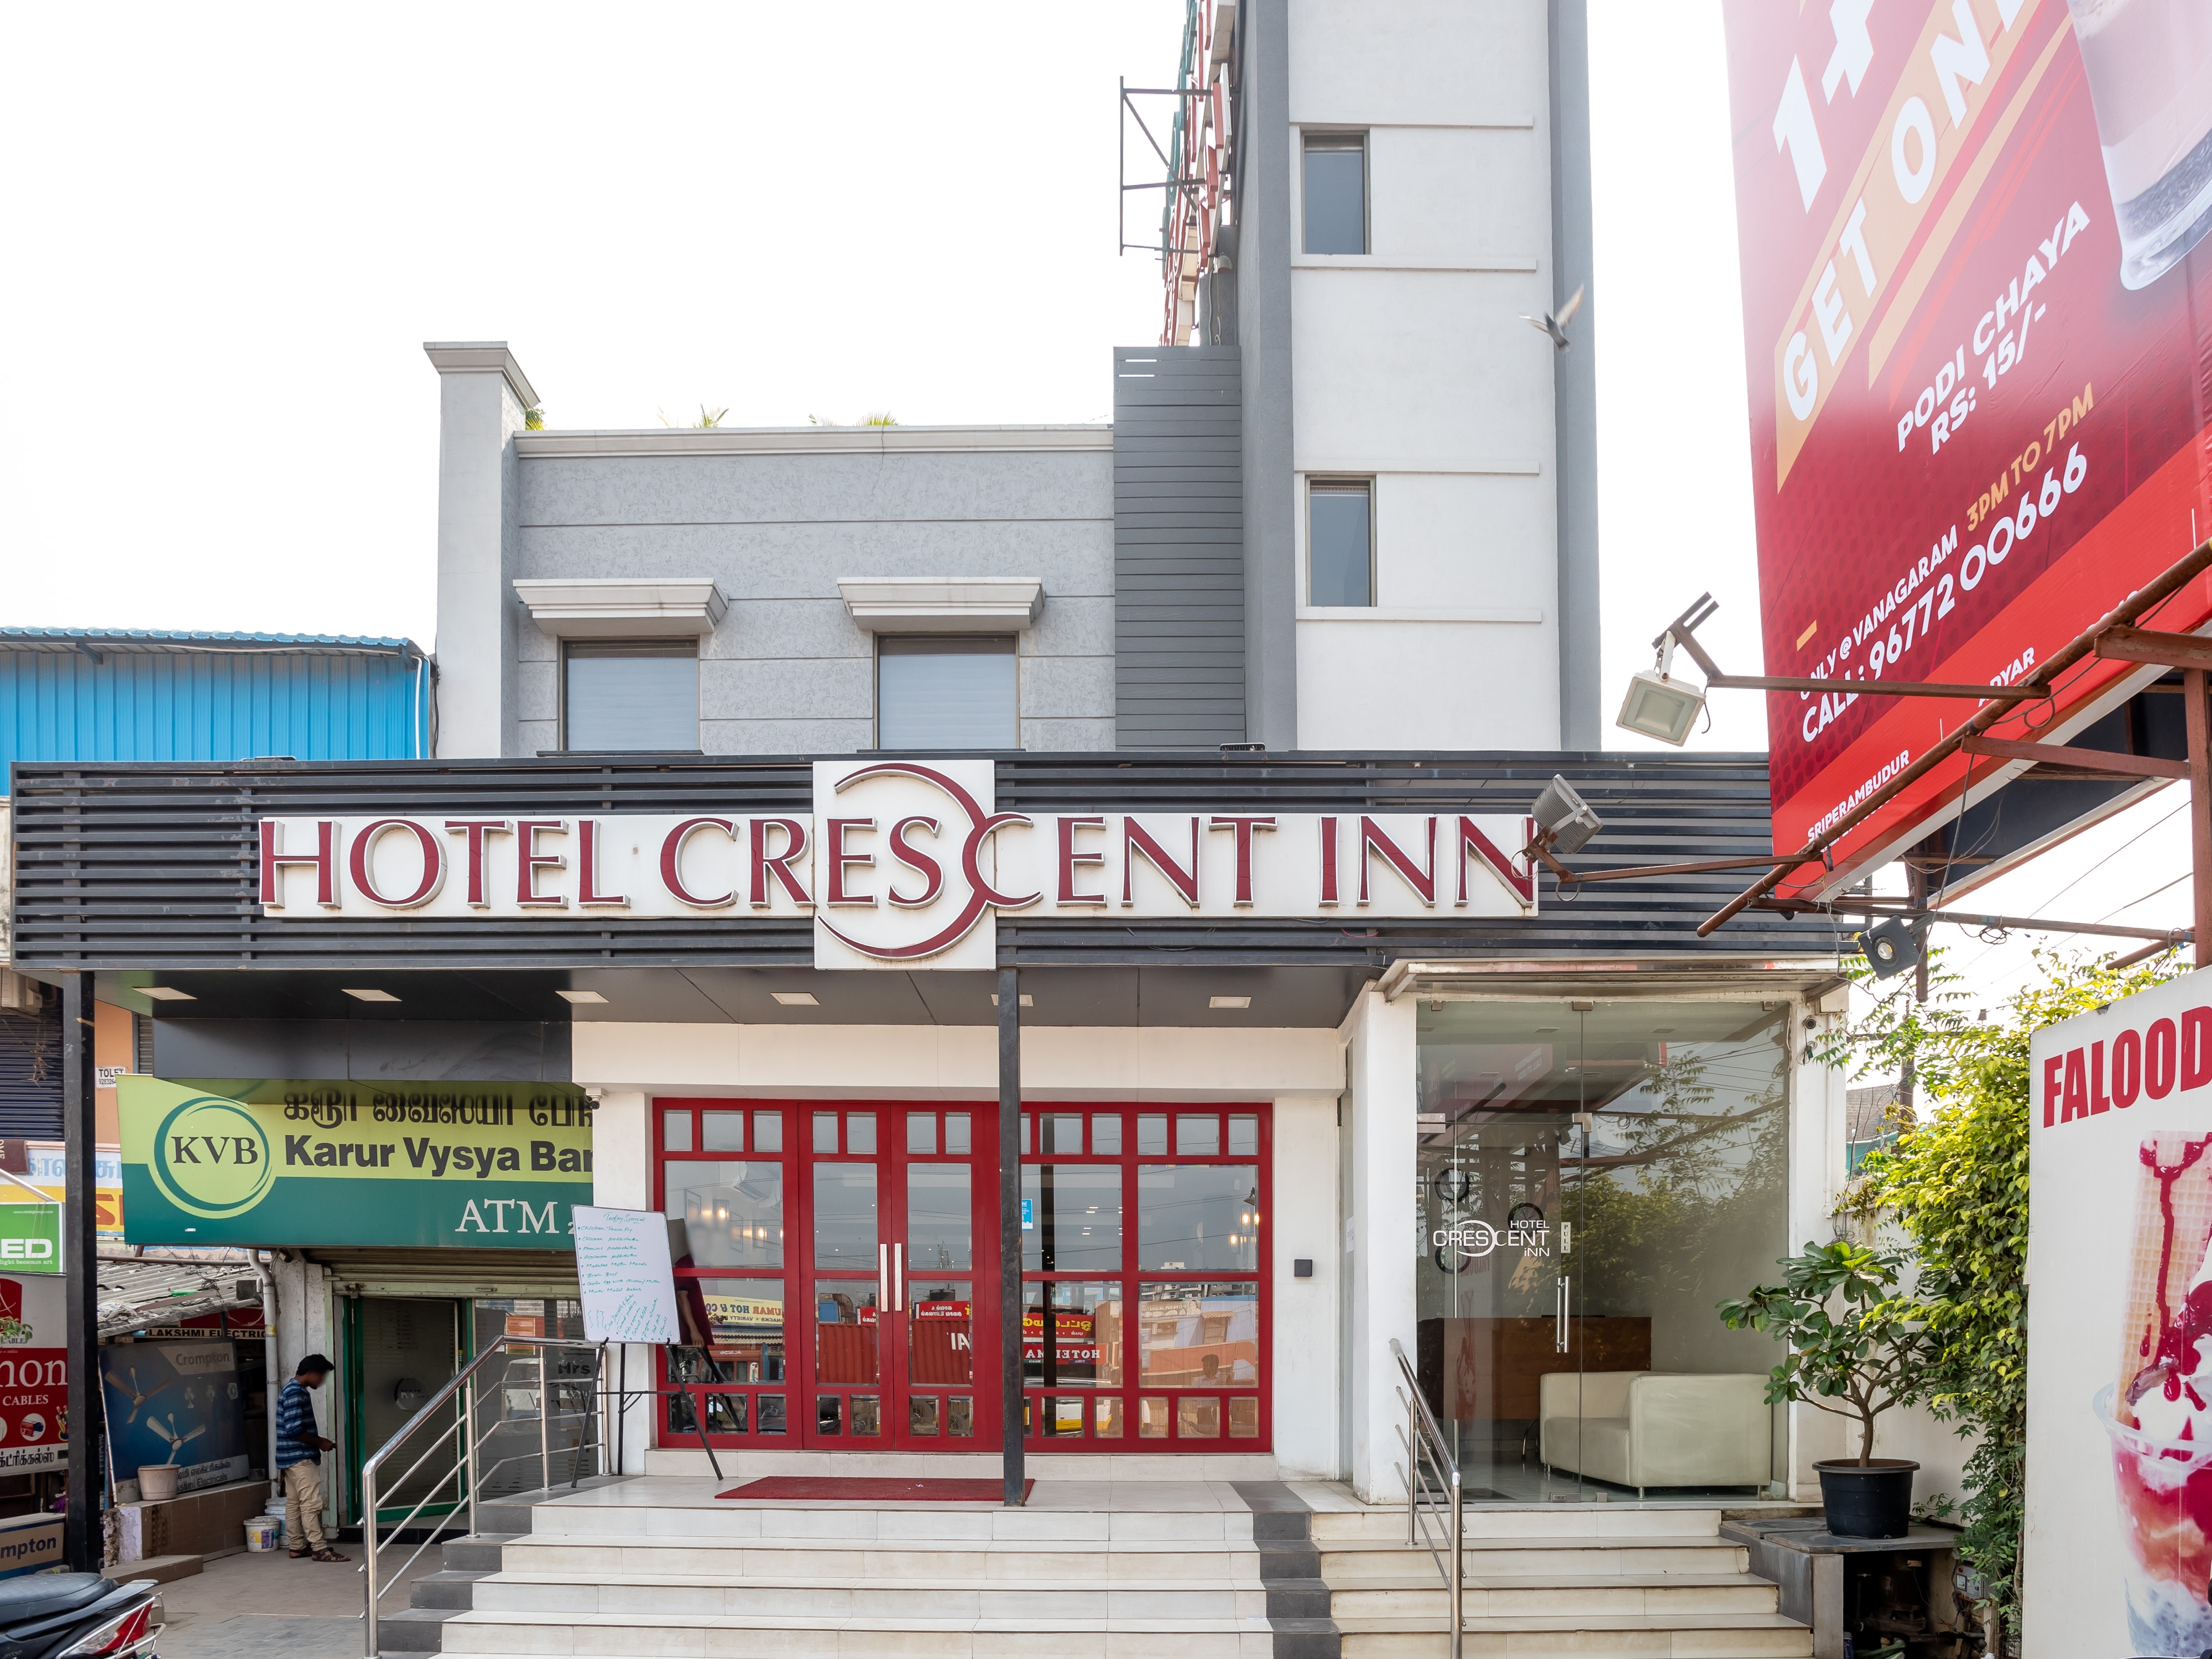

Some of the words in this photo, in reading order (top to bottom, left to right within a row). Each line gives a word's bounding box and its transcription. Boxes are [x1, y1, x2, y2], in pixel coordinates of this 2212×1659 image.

[1783, 197, 1877, 421] GET
[1891, 0, 2025, 204] ON
[1897, 345, 1965, 453] PODI
[1973, 200, 2091, 356] CHAYA
[1931, 385, 1978, 455] RS:
[1983, 299, 2047, 390] 15/-
[1966, 470, 2009, 531] 3PM
[2011, 440, 2041, 486] TO
[2044, 381, 2094, 450] 7PM
[1978, 647, 2035, 708] DYAR
[1807, 749, 1910, 844] SRIPERAMBUDUR
[258, 817, 630, 910] HOTEL
[660, 811, 1278, 910] CRESCENT
[1318, 815, 1536, 910] INN
[2043, 1005, 2212, 1129] FALOOD
[171, 1136, 259, 1165] KVB
[284, 1134, 395, 1167] Karur
[402, 1136, 520, 1178] Vysya
[455, 1198, 560, 1234] ATM
[1510, 1220, 1550, 1229] HOTEL
[0, 1238, 53, 1259] ED
[1433, 1230, 1550, 1246] CRESCENT
[149, 1328, 205, 1337] LAKSHMI
[175, 1353, 230, 1366] Crompton
[2, 1394, 49, 1406] CABLES
[197, 1472, 228, 1487] Electricals
